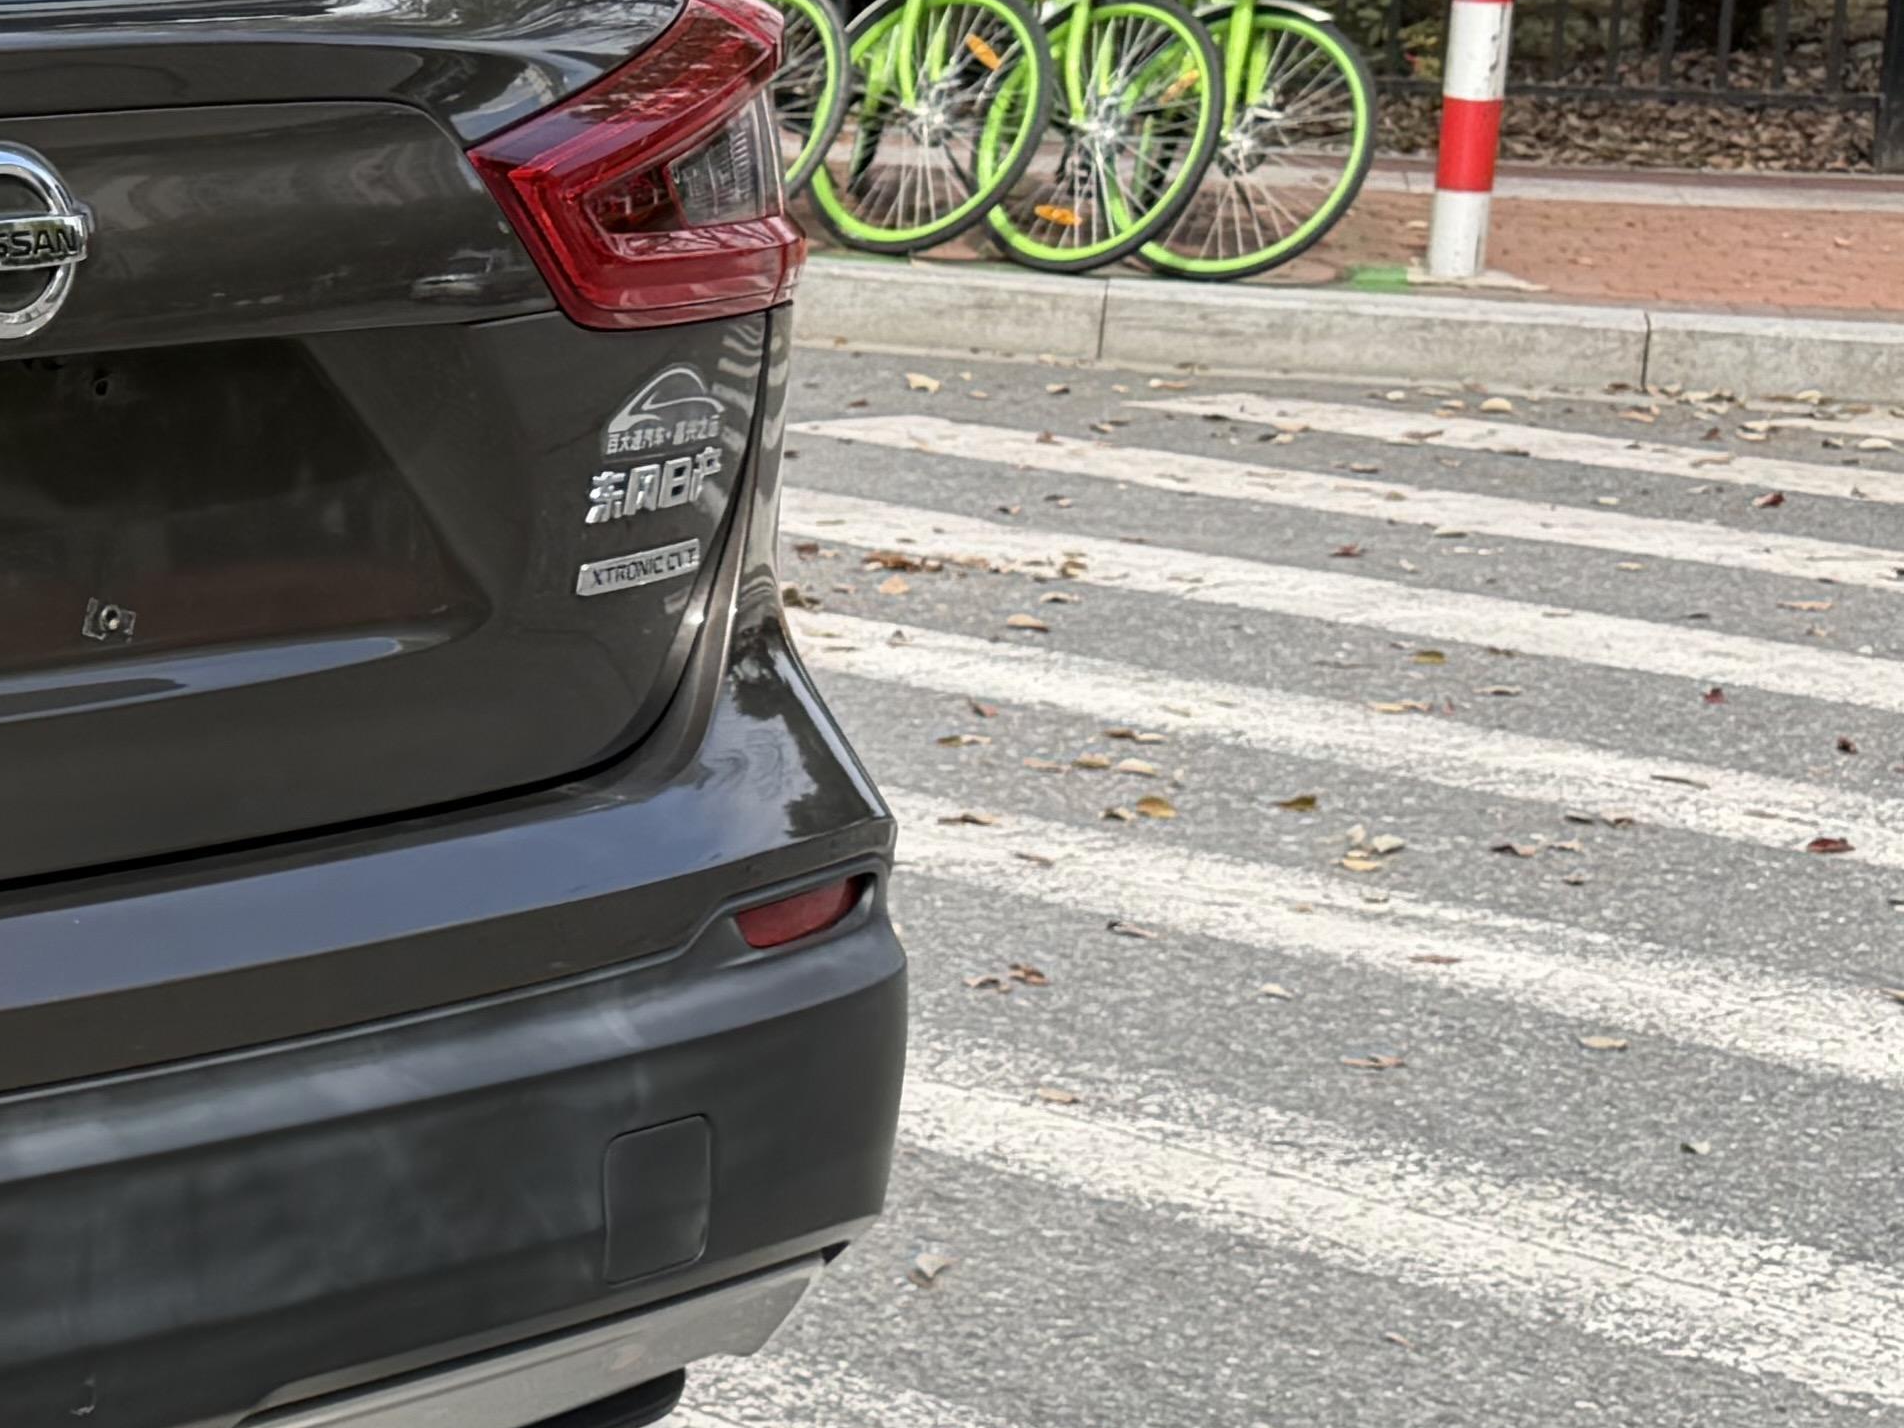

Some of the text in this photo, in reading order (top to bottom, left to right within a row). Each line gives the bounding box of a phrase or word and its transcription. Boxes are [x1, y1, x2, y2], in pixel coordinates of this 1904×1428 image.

[585, 445, 722, 524] 东风日产
[592, 547, 697, 586] XTRONIC CVT
